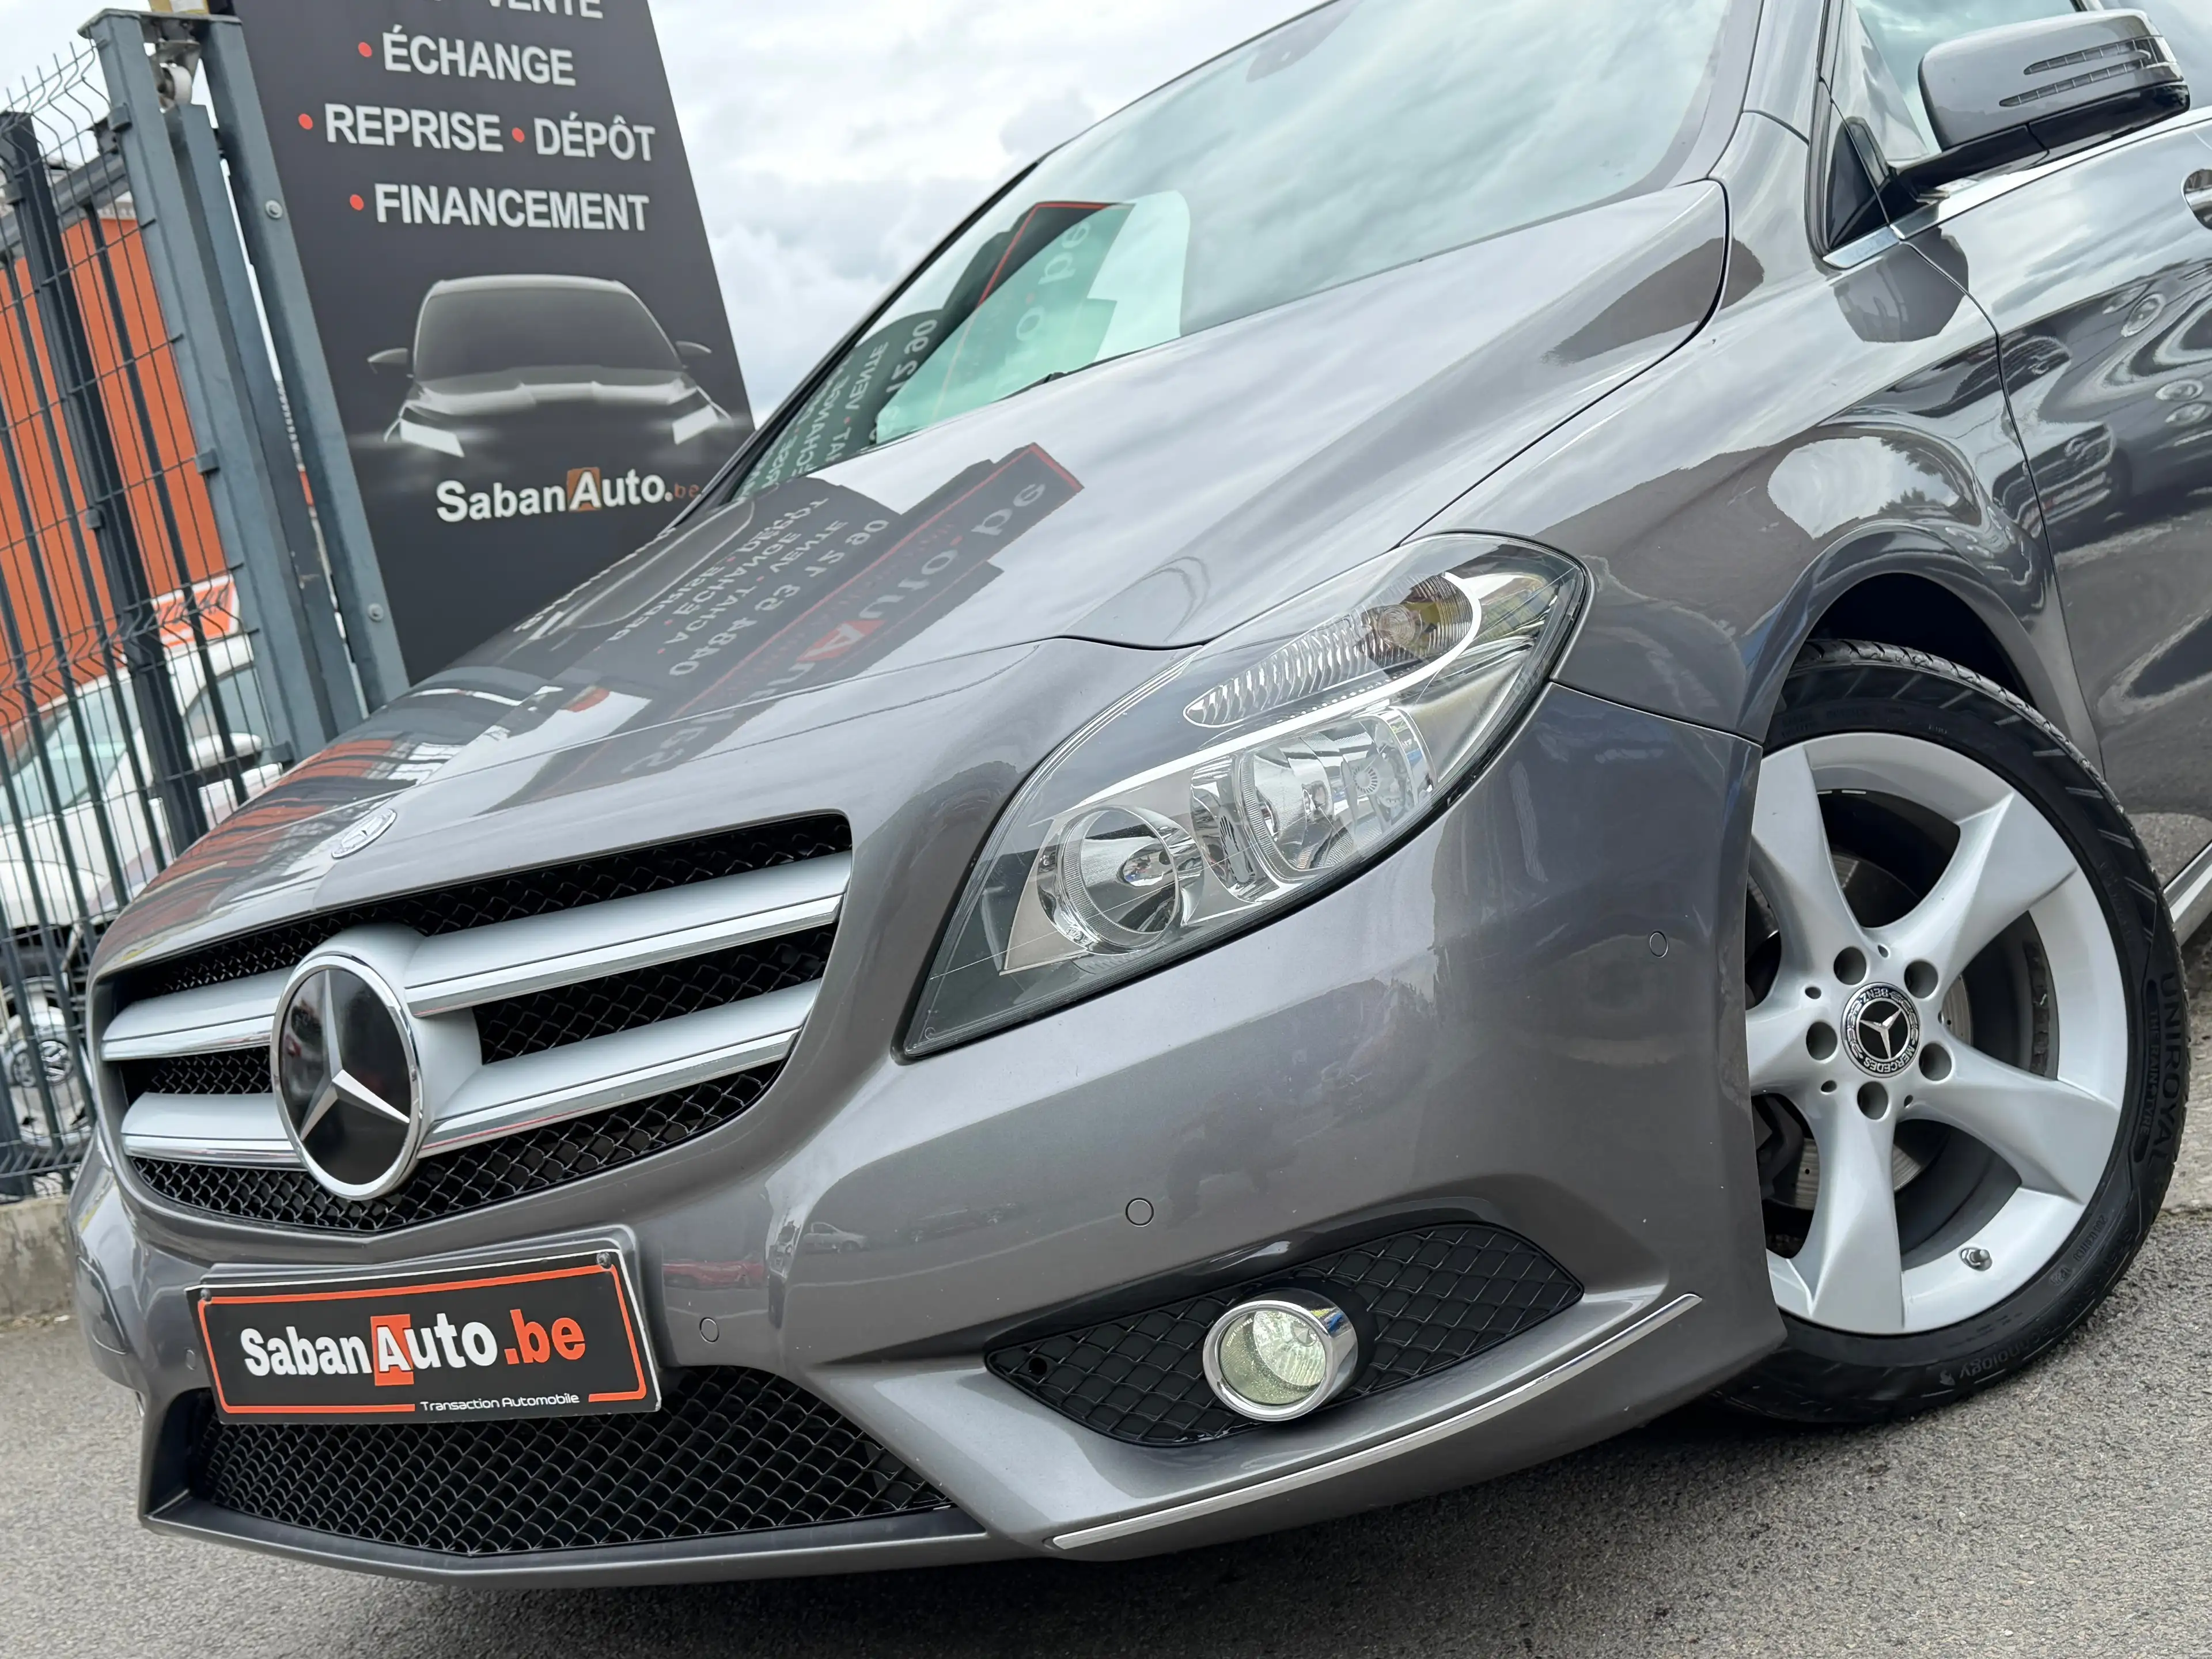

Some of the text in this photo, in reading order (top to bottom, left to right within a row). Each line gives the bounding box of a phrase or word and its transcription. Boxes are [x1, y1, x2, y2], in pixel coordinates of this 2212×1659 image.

[382, 24, 576, 86] ÉCHANGE
[324, 103, 656, 161] REPRISE DÉPÔT
[374, 183, 650, 231] FINANCEMENT
[435, 468, 700, 522] SabanAuto.be
[1859, 987, 1889, 1003] BENZ
[1863, 1044, 1915, 1073] MERCEDES
[2149, 972, 2181, 1161] UNIROYAL
[240, 1308, 586, 1377] SabanAuto.be
[419, 1392, 580, 1411] Transaction Automobile
